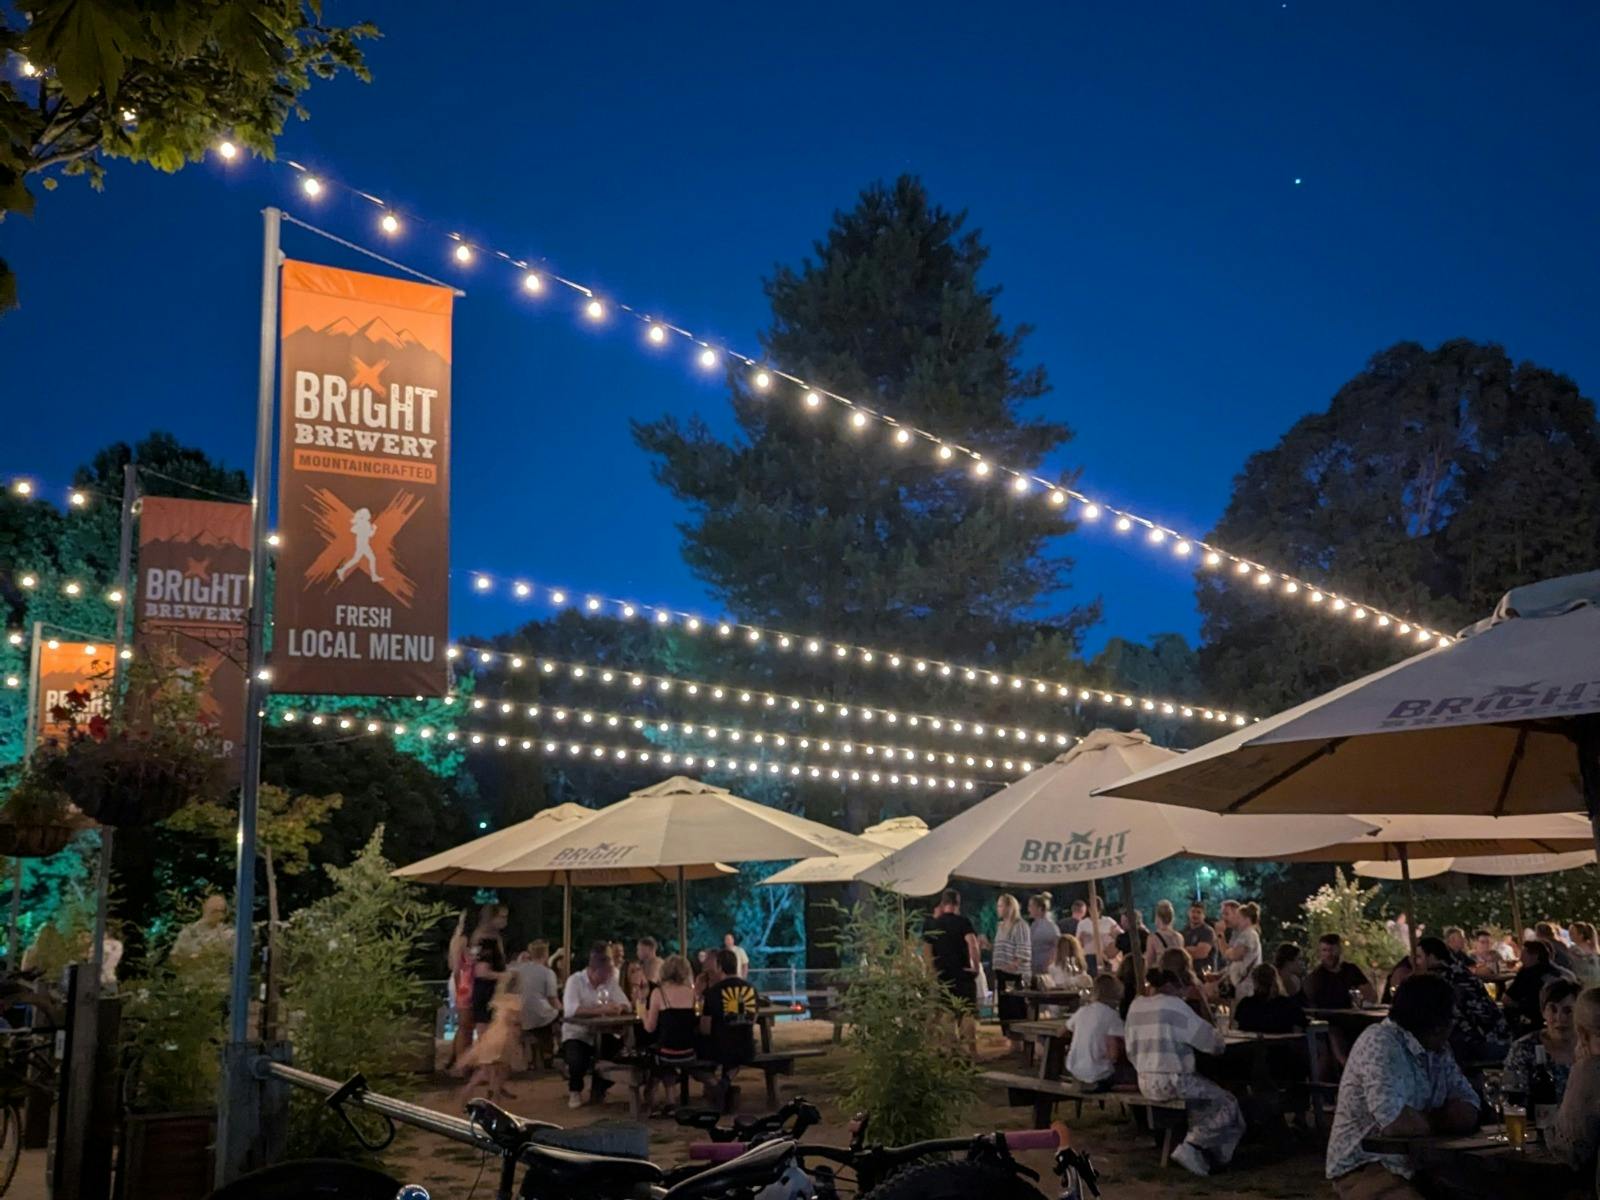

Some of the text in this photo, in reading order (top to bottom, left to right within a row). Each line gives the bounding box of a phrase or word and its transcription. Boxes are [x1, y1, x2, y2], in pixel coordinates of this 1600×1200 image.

[295, 370, 438, 434] BRIGHT
[294, 423, 437, 459] BREWERY
[299, 454, 433, 479] MOUNTAINCRAFTED
[145, 568, 246, 605] BRIGHT
[144, 602, 244, 622] BREWERY
[335, 604, 392, 628] FRESH
[288, 628, 434, 662] LOCAL MENU
[1020, 828, 1131, 862] BRIGHT
